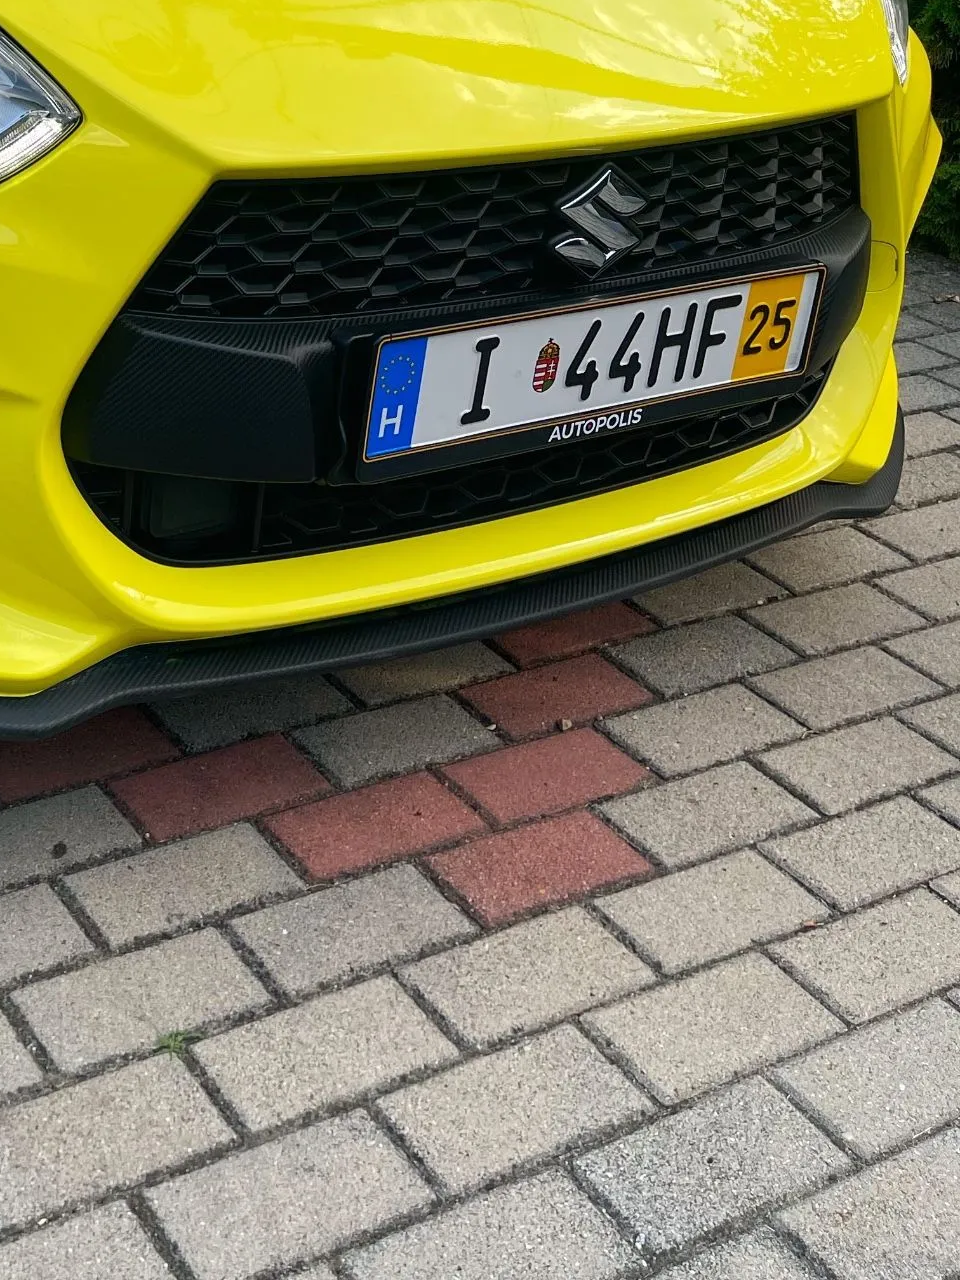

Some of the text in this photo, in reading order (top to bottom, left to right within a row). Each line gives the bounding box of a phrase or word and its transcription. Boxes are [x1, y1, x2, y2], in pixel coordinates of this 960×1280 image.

[460, 295, 797, 425] I 44HF 25
[378, 404, 403, 438] H
[548, 408, 643, 442] AUTOPOLIS
